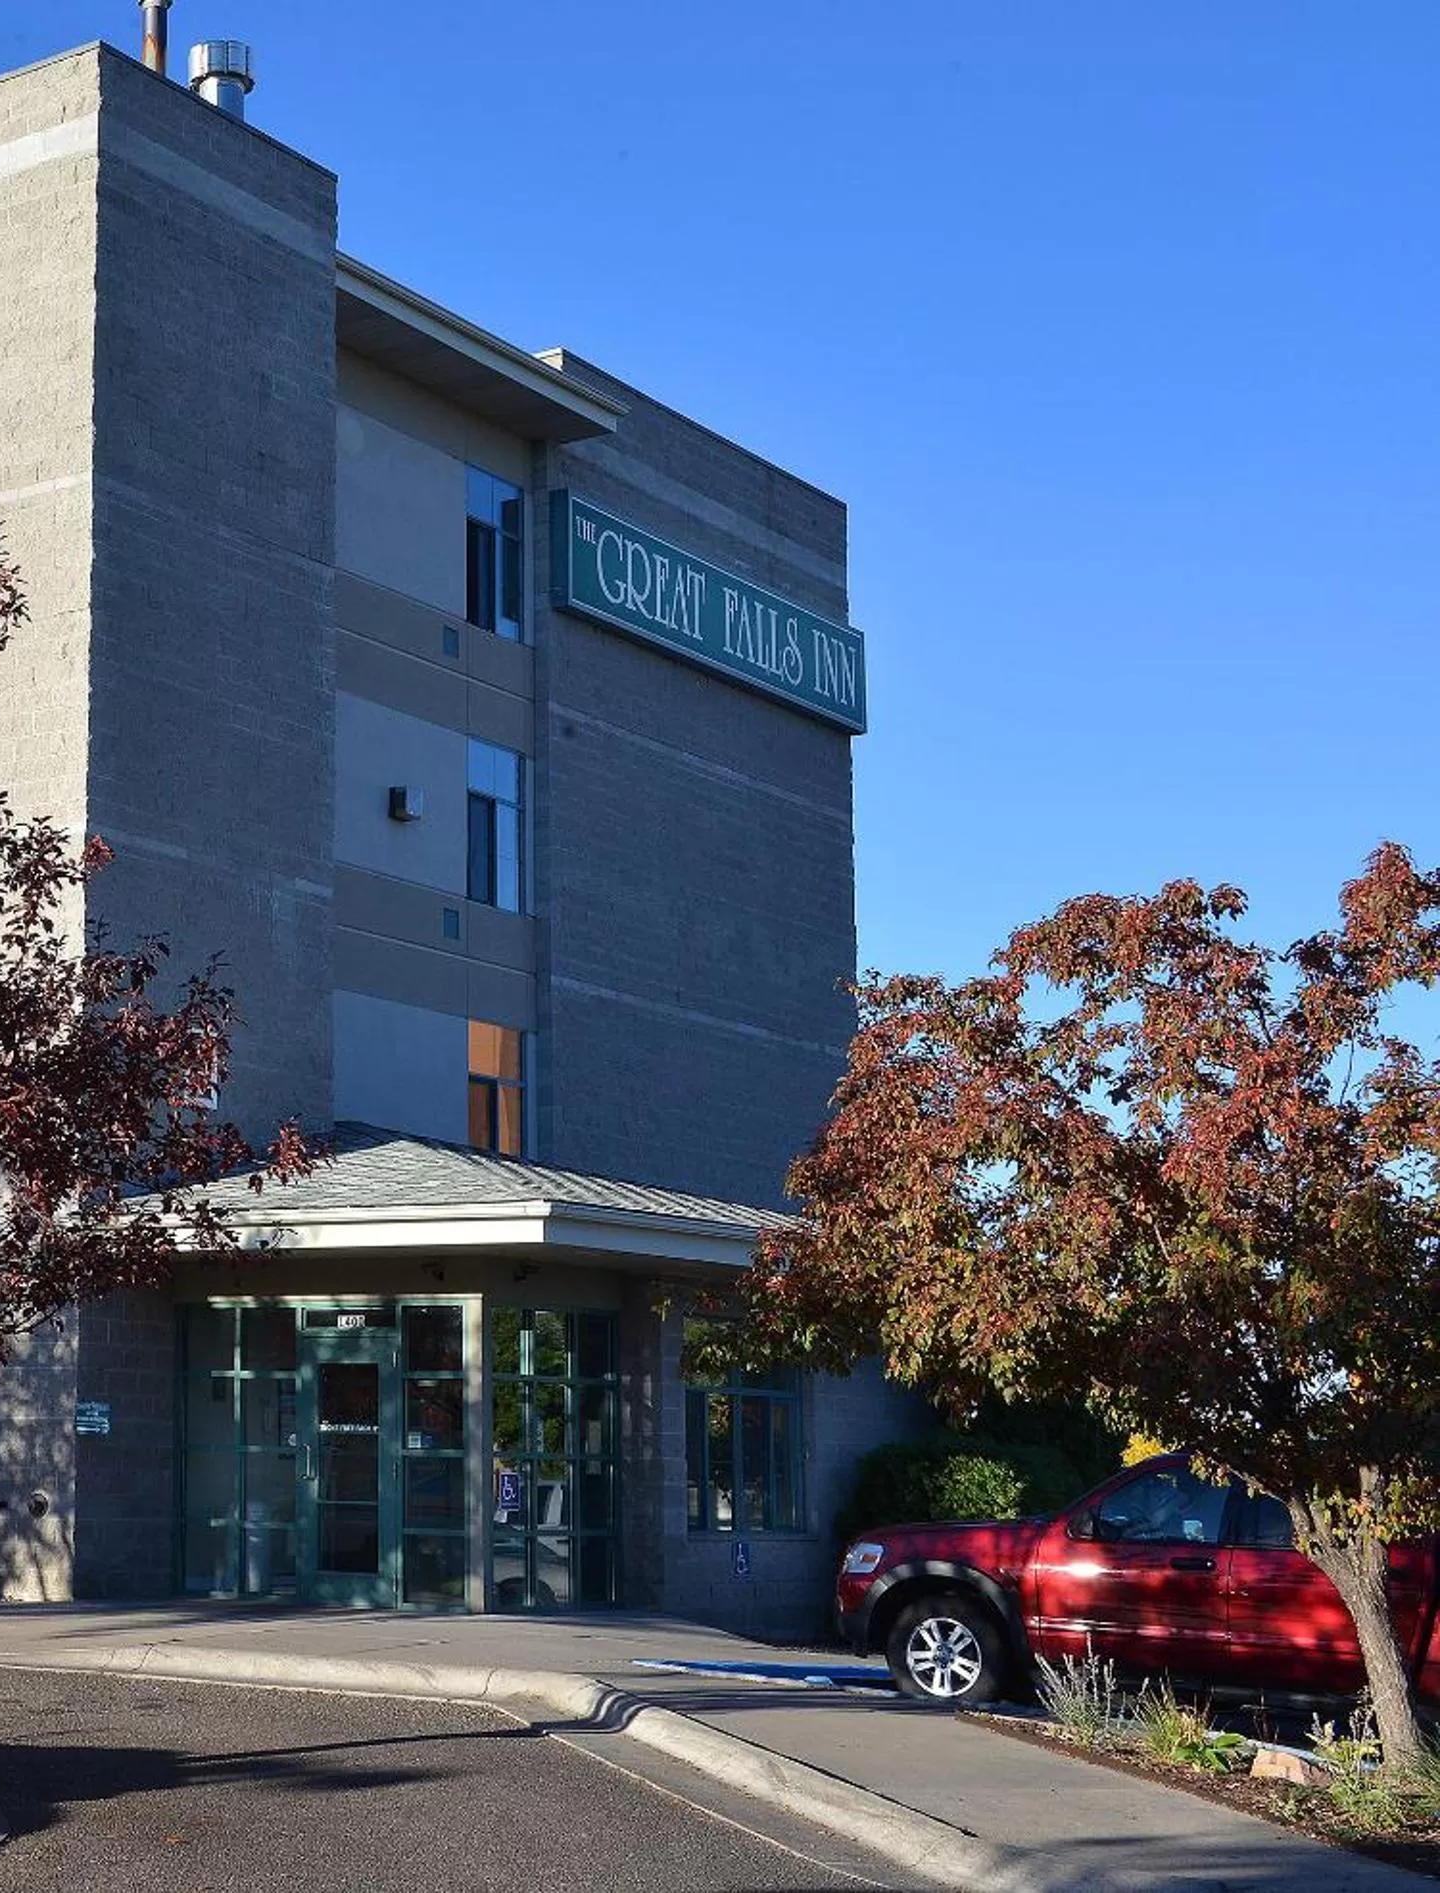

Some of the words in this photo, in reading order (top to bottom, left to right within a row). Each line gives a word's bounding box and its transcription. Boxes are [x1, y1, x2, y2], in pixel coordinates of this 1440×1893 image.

[576, 515, 596, 545] THE
[596, 529, 706, 641] GREAT
[722, 586, 804, 686] FALLS
[812, 629, 857, 707] INN
